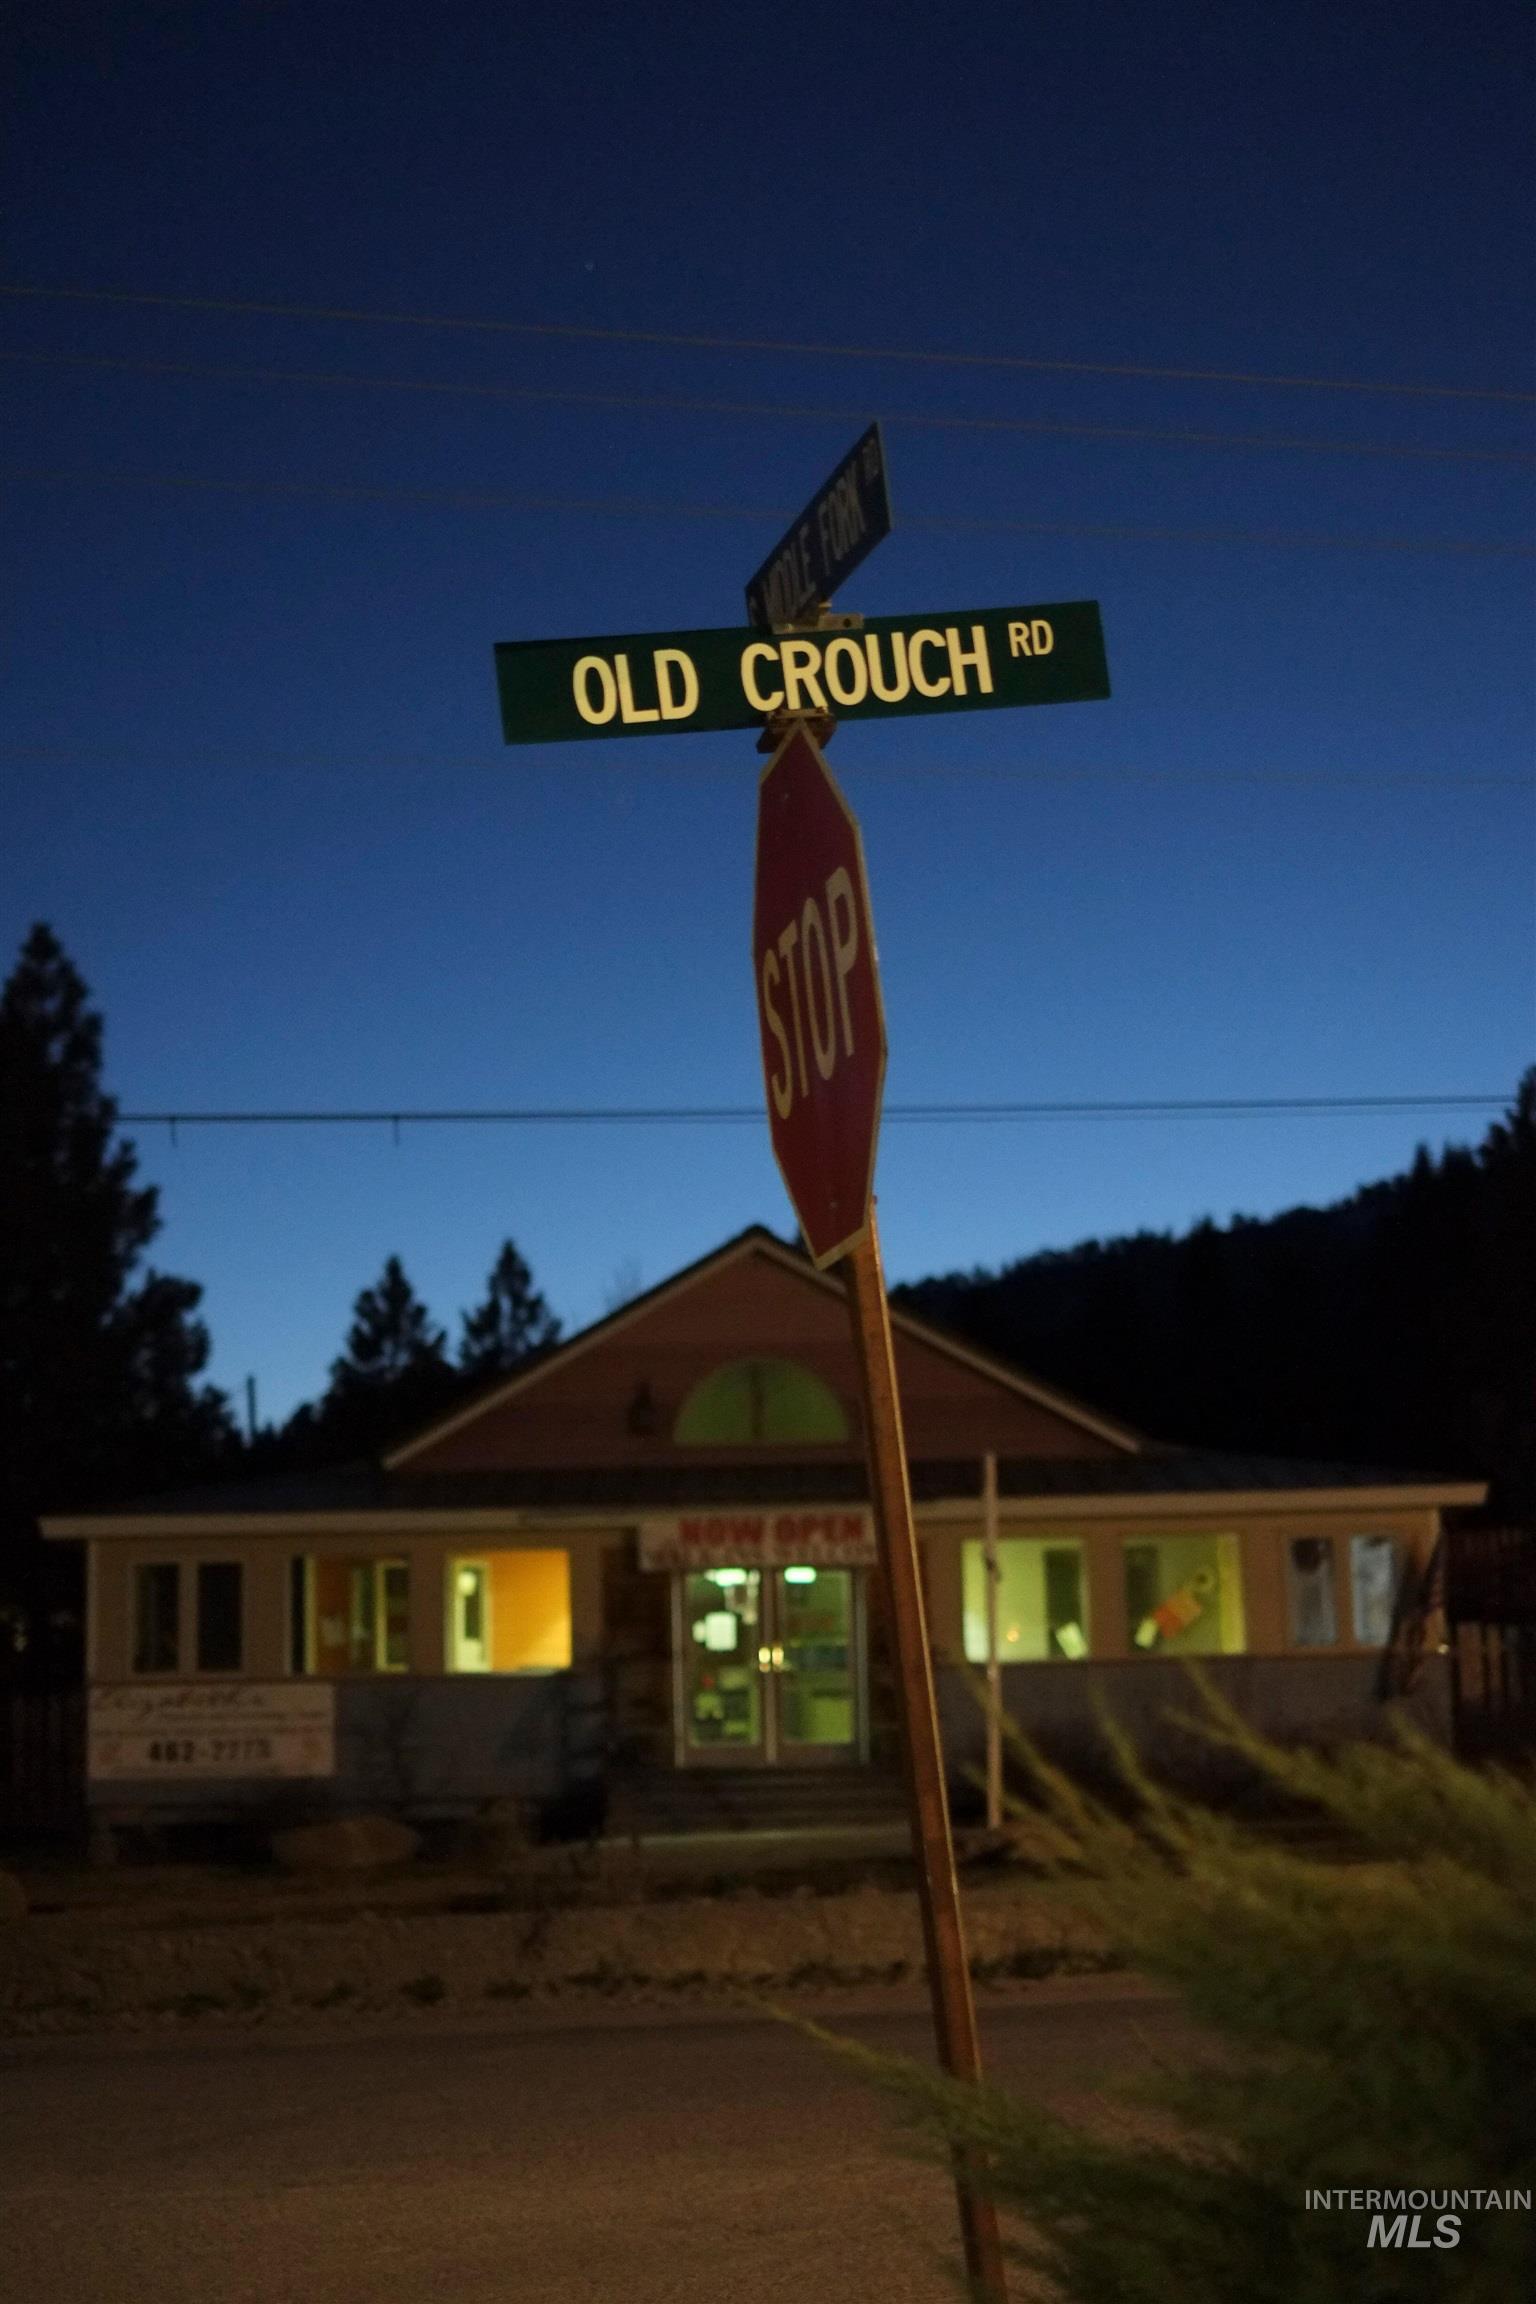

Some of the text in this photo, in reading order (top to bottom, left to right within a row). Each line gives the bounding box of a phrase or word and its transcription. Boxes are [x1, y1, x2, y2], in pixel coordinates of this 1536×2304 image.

[818, 460, 865, 576] FORK
[572, 619, 1055, 726] OLD CROUCH RD
[763, 866, 858, 1119] STOP
[680, 1511, 864, 1543] NOW OPEN
